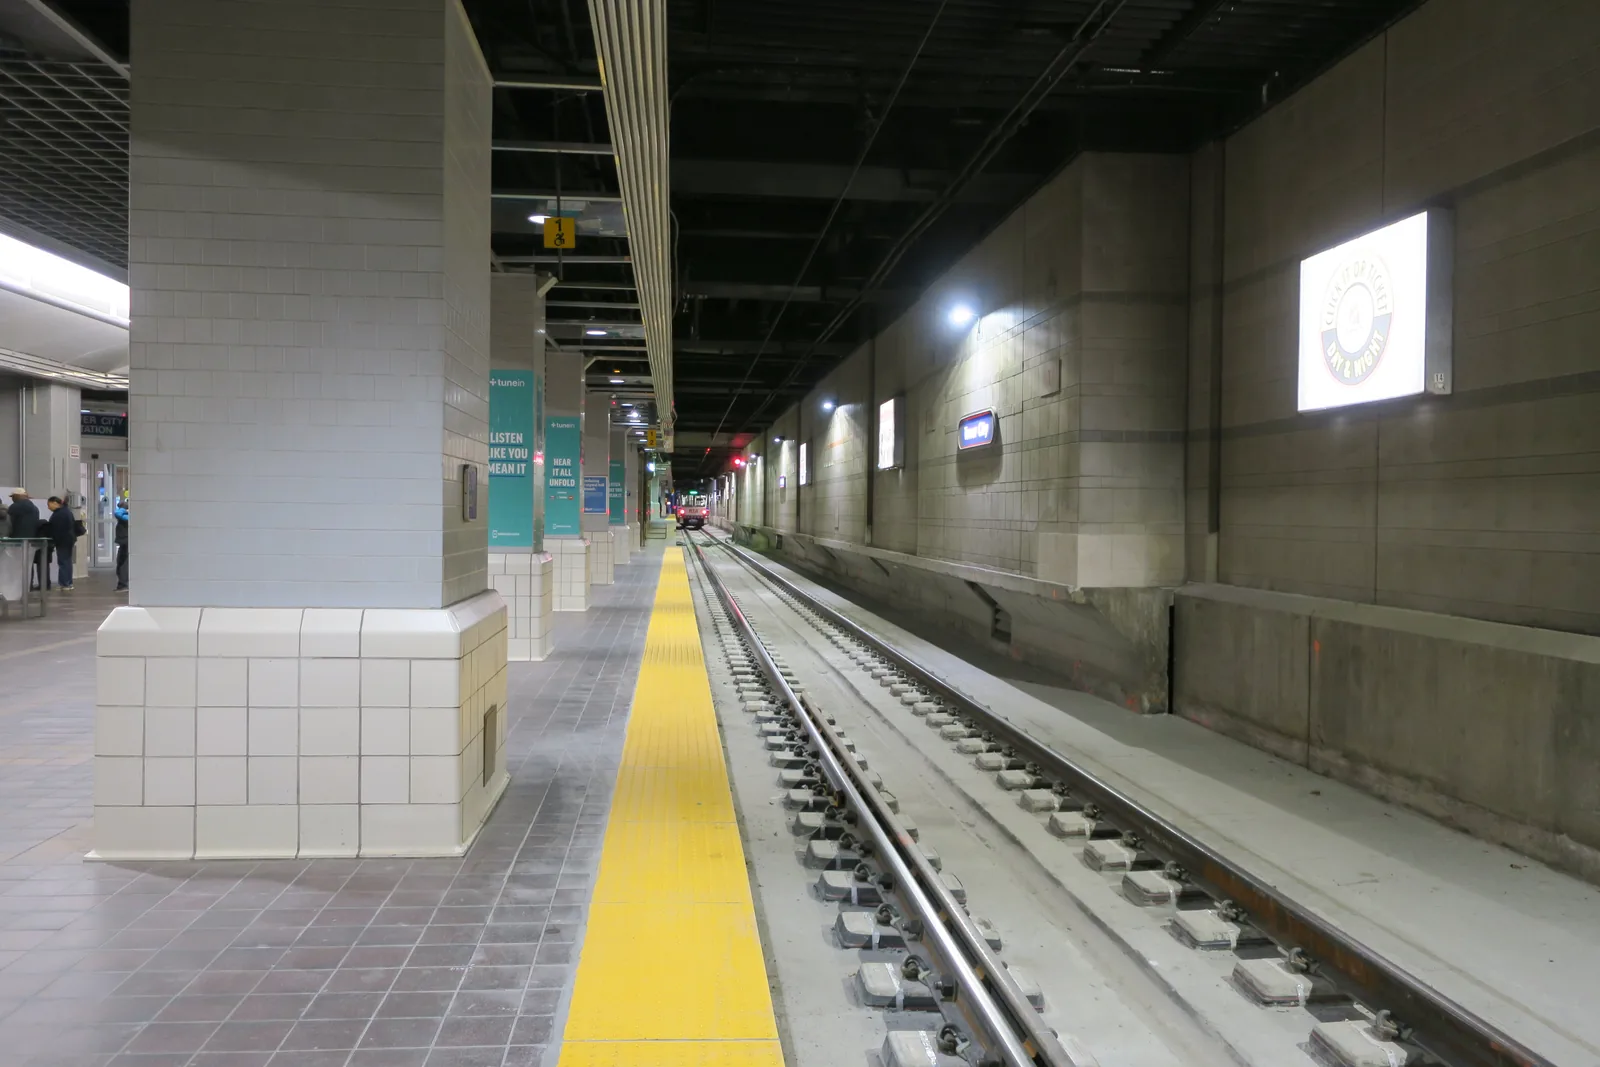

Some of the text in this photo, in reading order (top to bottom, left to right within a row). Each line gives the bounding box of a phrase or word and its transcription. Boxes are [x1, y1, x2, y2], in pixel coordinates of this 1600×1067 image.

[1326, 330, 1385, 378] DAY & NIGHT
[497, 379, 525, 387] tunein
[490, 432, 523, 444] LISTEN
[488, 448, 528, 459] IKE YOU
[553, 458, 572, 466] HEAR
[488, 463, 526, 475] MEAN IT
[552, 468, 572, 476] IT ALL
[549, 479, 576, 487] UNFOLD
